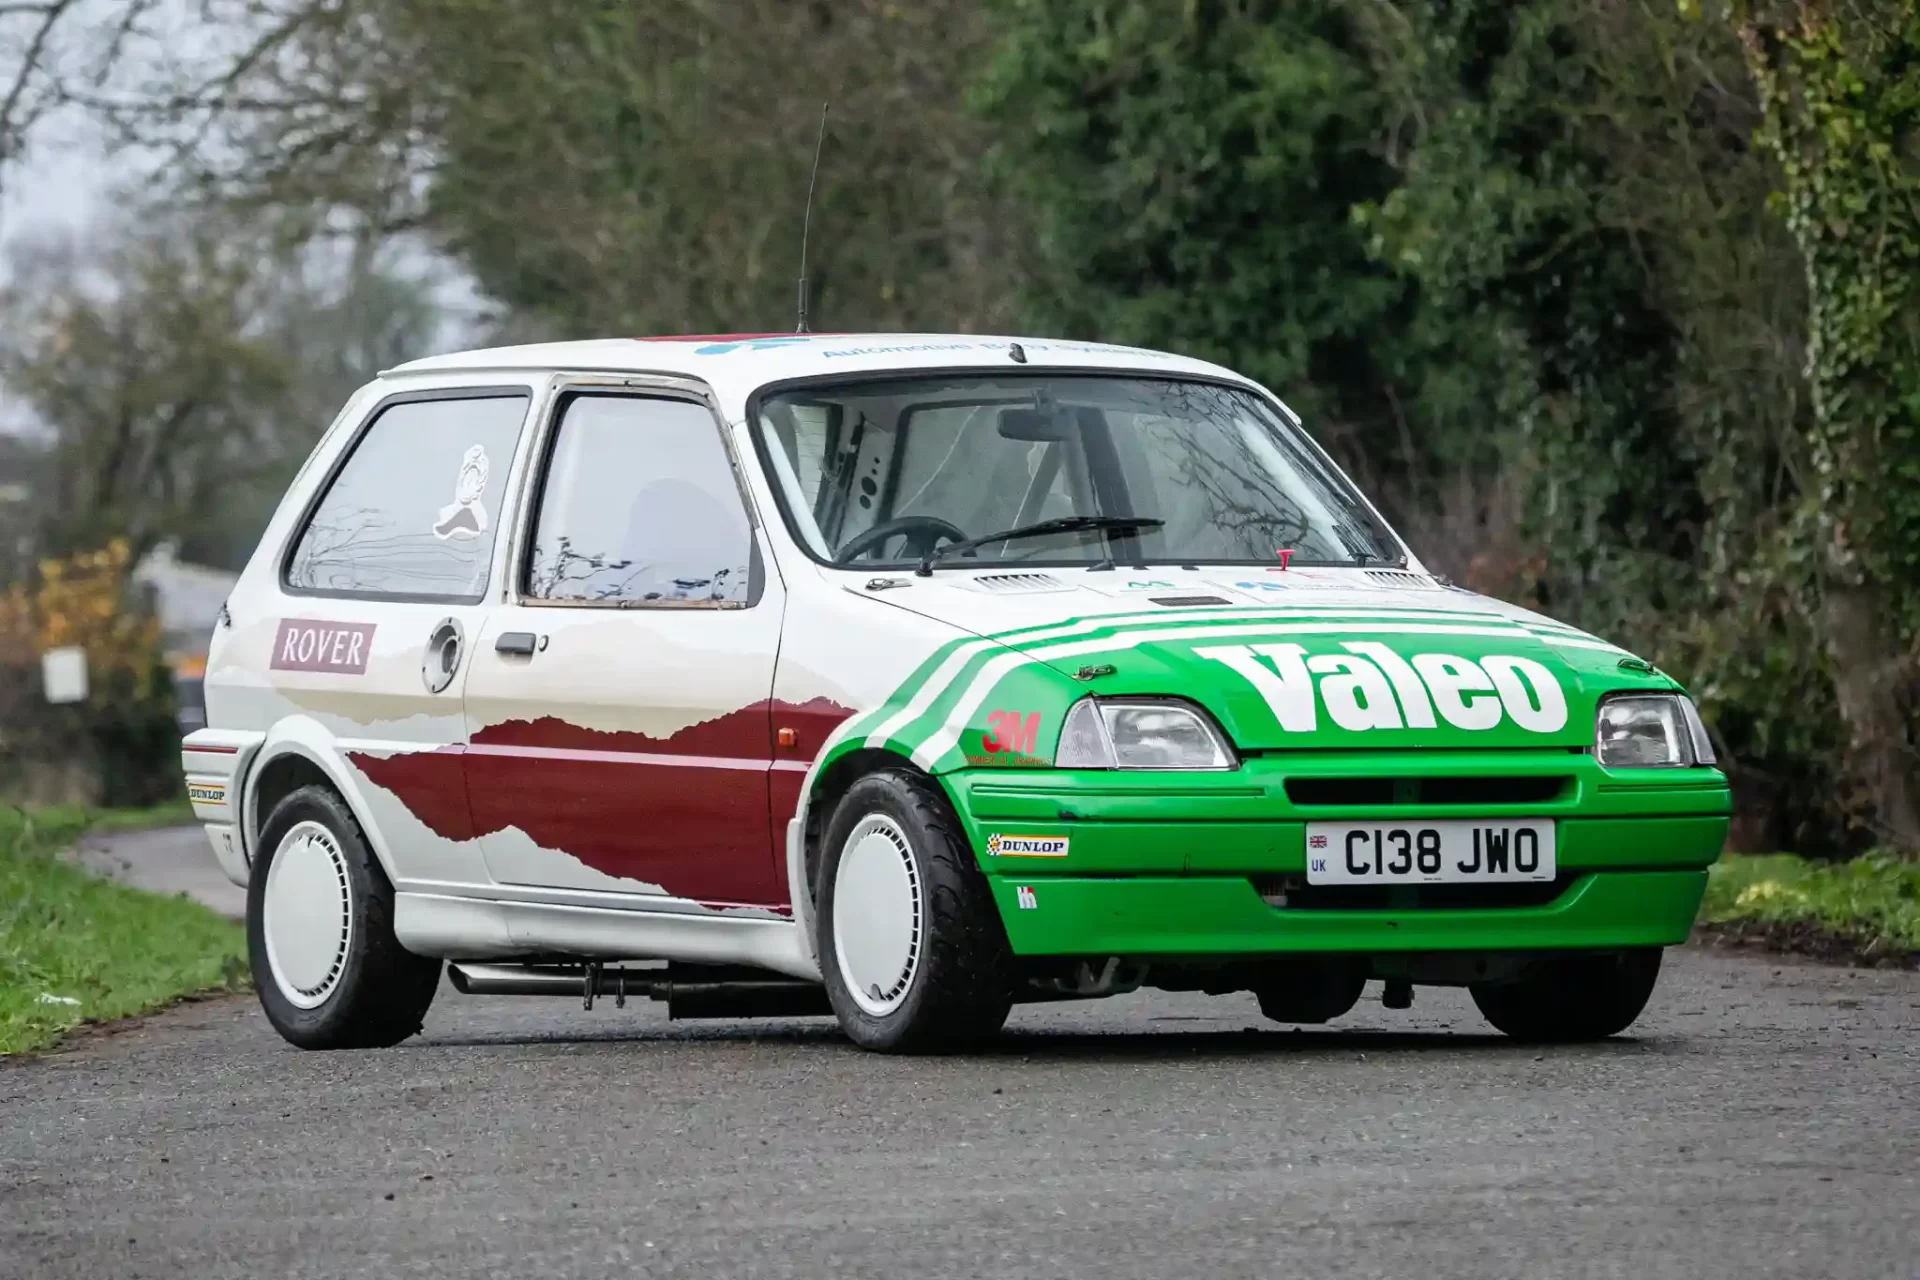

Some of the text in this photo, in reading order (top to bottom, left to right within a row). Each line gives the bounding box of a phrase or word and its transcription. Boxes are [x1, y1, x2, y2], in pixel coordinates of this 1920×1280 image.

[980, 342, 1049, 351] Boy
[282, 628, 364, 665] ROVER
[1191, 641, 1568, 733] Valeo
[982, 709, 1041, 754] 3M
[190, 789, 225, 800] DUNLOP
[1002, 840, 1064, 852] DUNLOP
[1345, 828, 1538, 875] C138 JWO
[1311, 859, 1326, 872] UK
